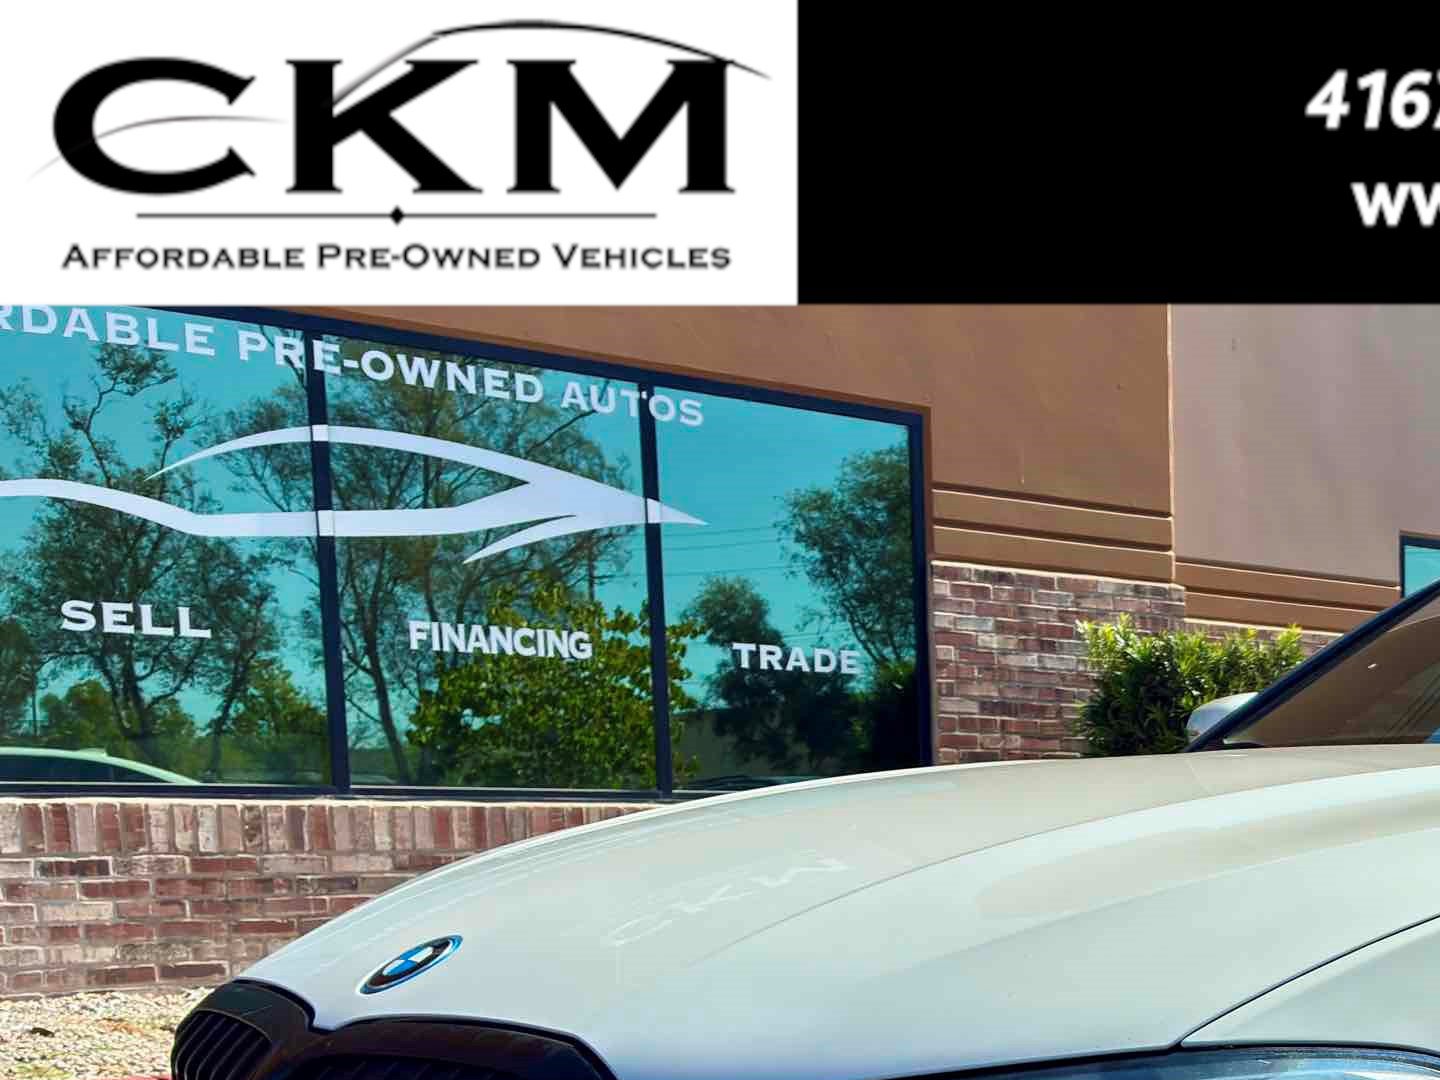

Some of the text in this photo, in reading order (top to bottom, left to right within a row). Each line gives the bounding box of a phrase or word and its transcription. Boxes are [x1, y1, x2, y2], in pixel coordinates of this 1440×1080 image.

[237, 330, 544, 403] PRE-OWNED
[560, 381, 705, 427] AUTOS
[61, 599, 212, 639] SELL
[408, 620, 593, 660] FINANCING
[731, 642, 864, 675] TRADE
